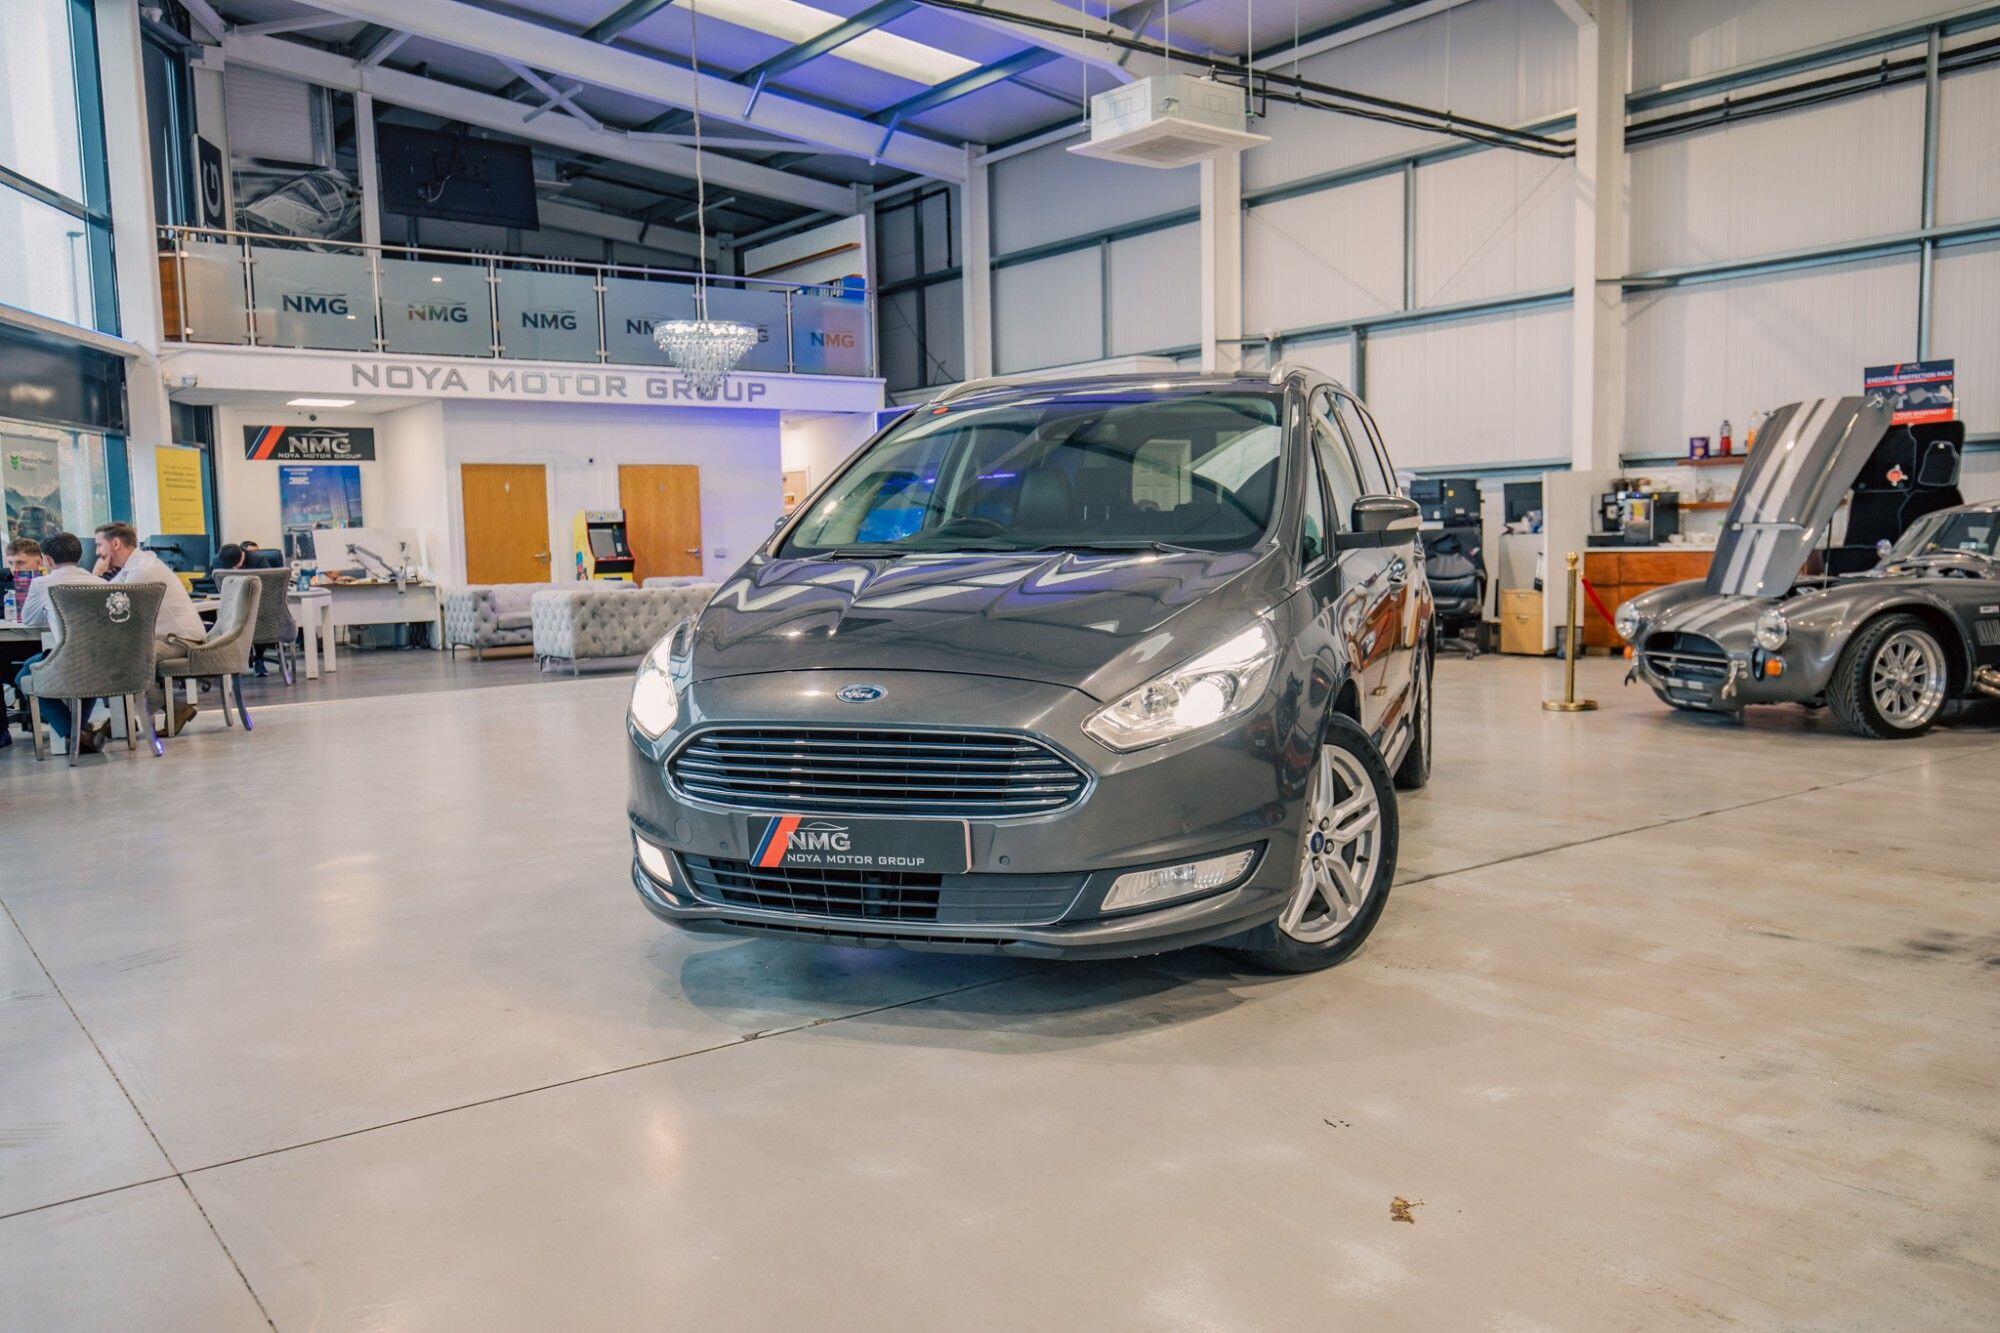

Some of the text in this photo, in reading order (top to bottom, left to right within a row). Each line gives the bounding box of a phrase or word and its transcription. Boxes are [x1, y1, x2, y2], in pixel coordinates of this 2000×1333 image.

[282, 294, 348, 315] NMG
[408, 303, 468, 323] NMG
[521, 312, 577, 330] NMG
[811, 332, 855, 348] NMG
[352, 364, 468, 391] NOYA
[488, 370, 627, 397] MOTOR
[288, 436, 351, 454] NMG
[844, 687, 876, 699] Ford
[787, 832, 851, 851] NMG
[787, 853, 925, 866] NOYA MOTOR GROUP
